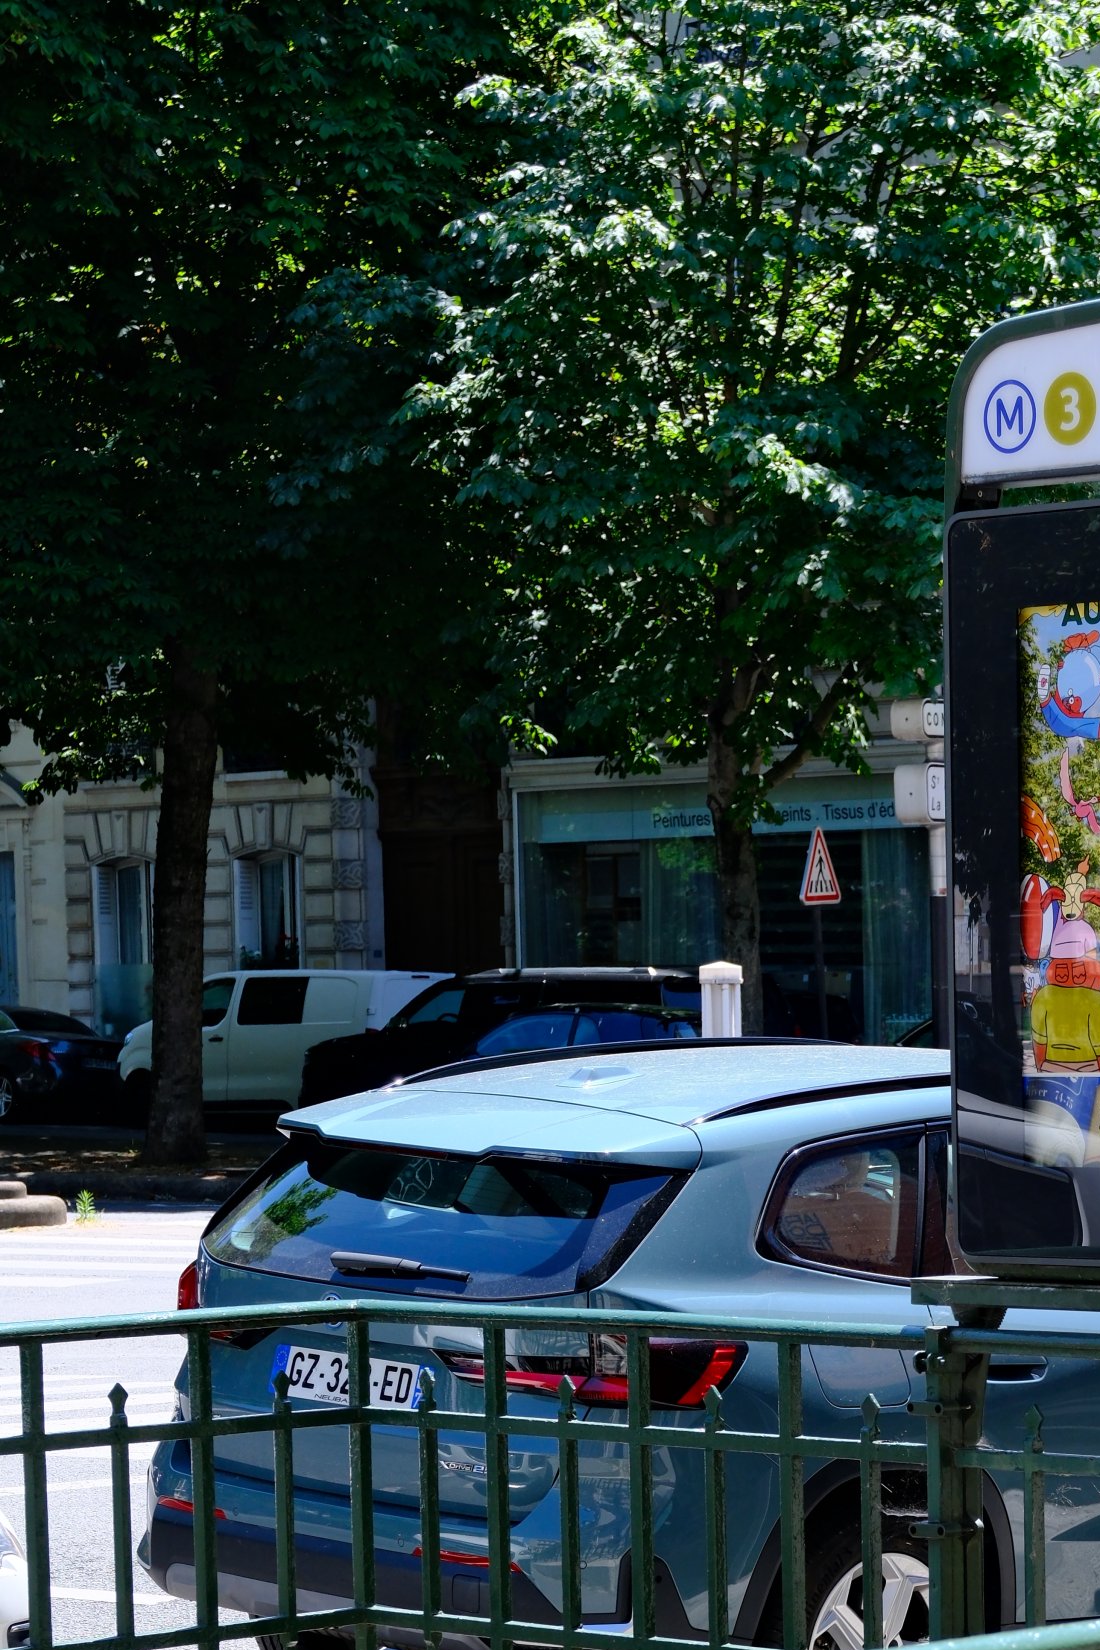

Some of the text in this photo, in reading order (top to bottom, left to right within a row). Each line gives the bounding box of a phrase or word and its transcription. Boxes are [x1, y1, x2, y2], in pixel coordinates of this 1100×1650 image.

[1060, 388, 1081, 431] 3
[1062, 602, 1100, 627] AU
[652, 813, 710, 829] Peintures
[823, 803, 864, 821] Tissus
[868, 802, 895, 819] d'éd
[288, 1351, 413, 1404] GZ-32-ED
[314, 1393, 349, 1404] NEUBA
